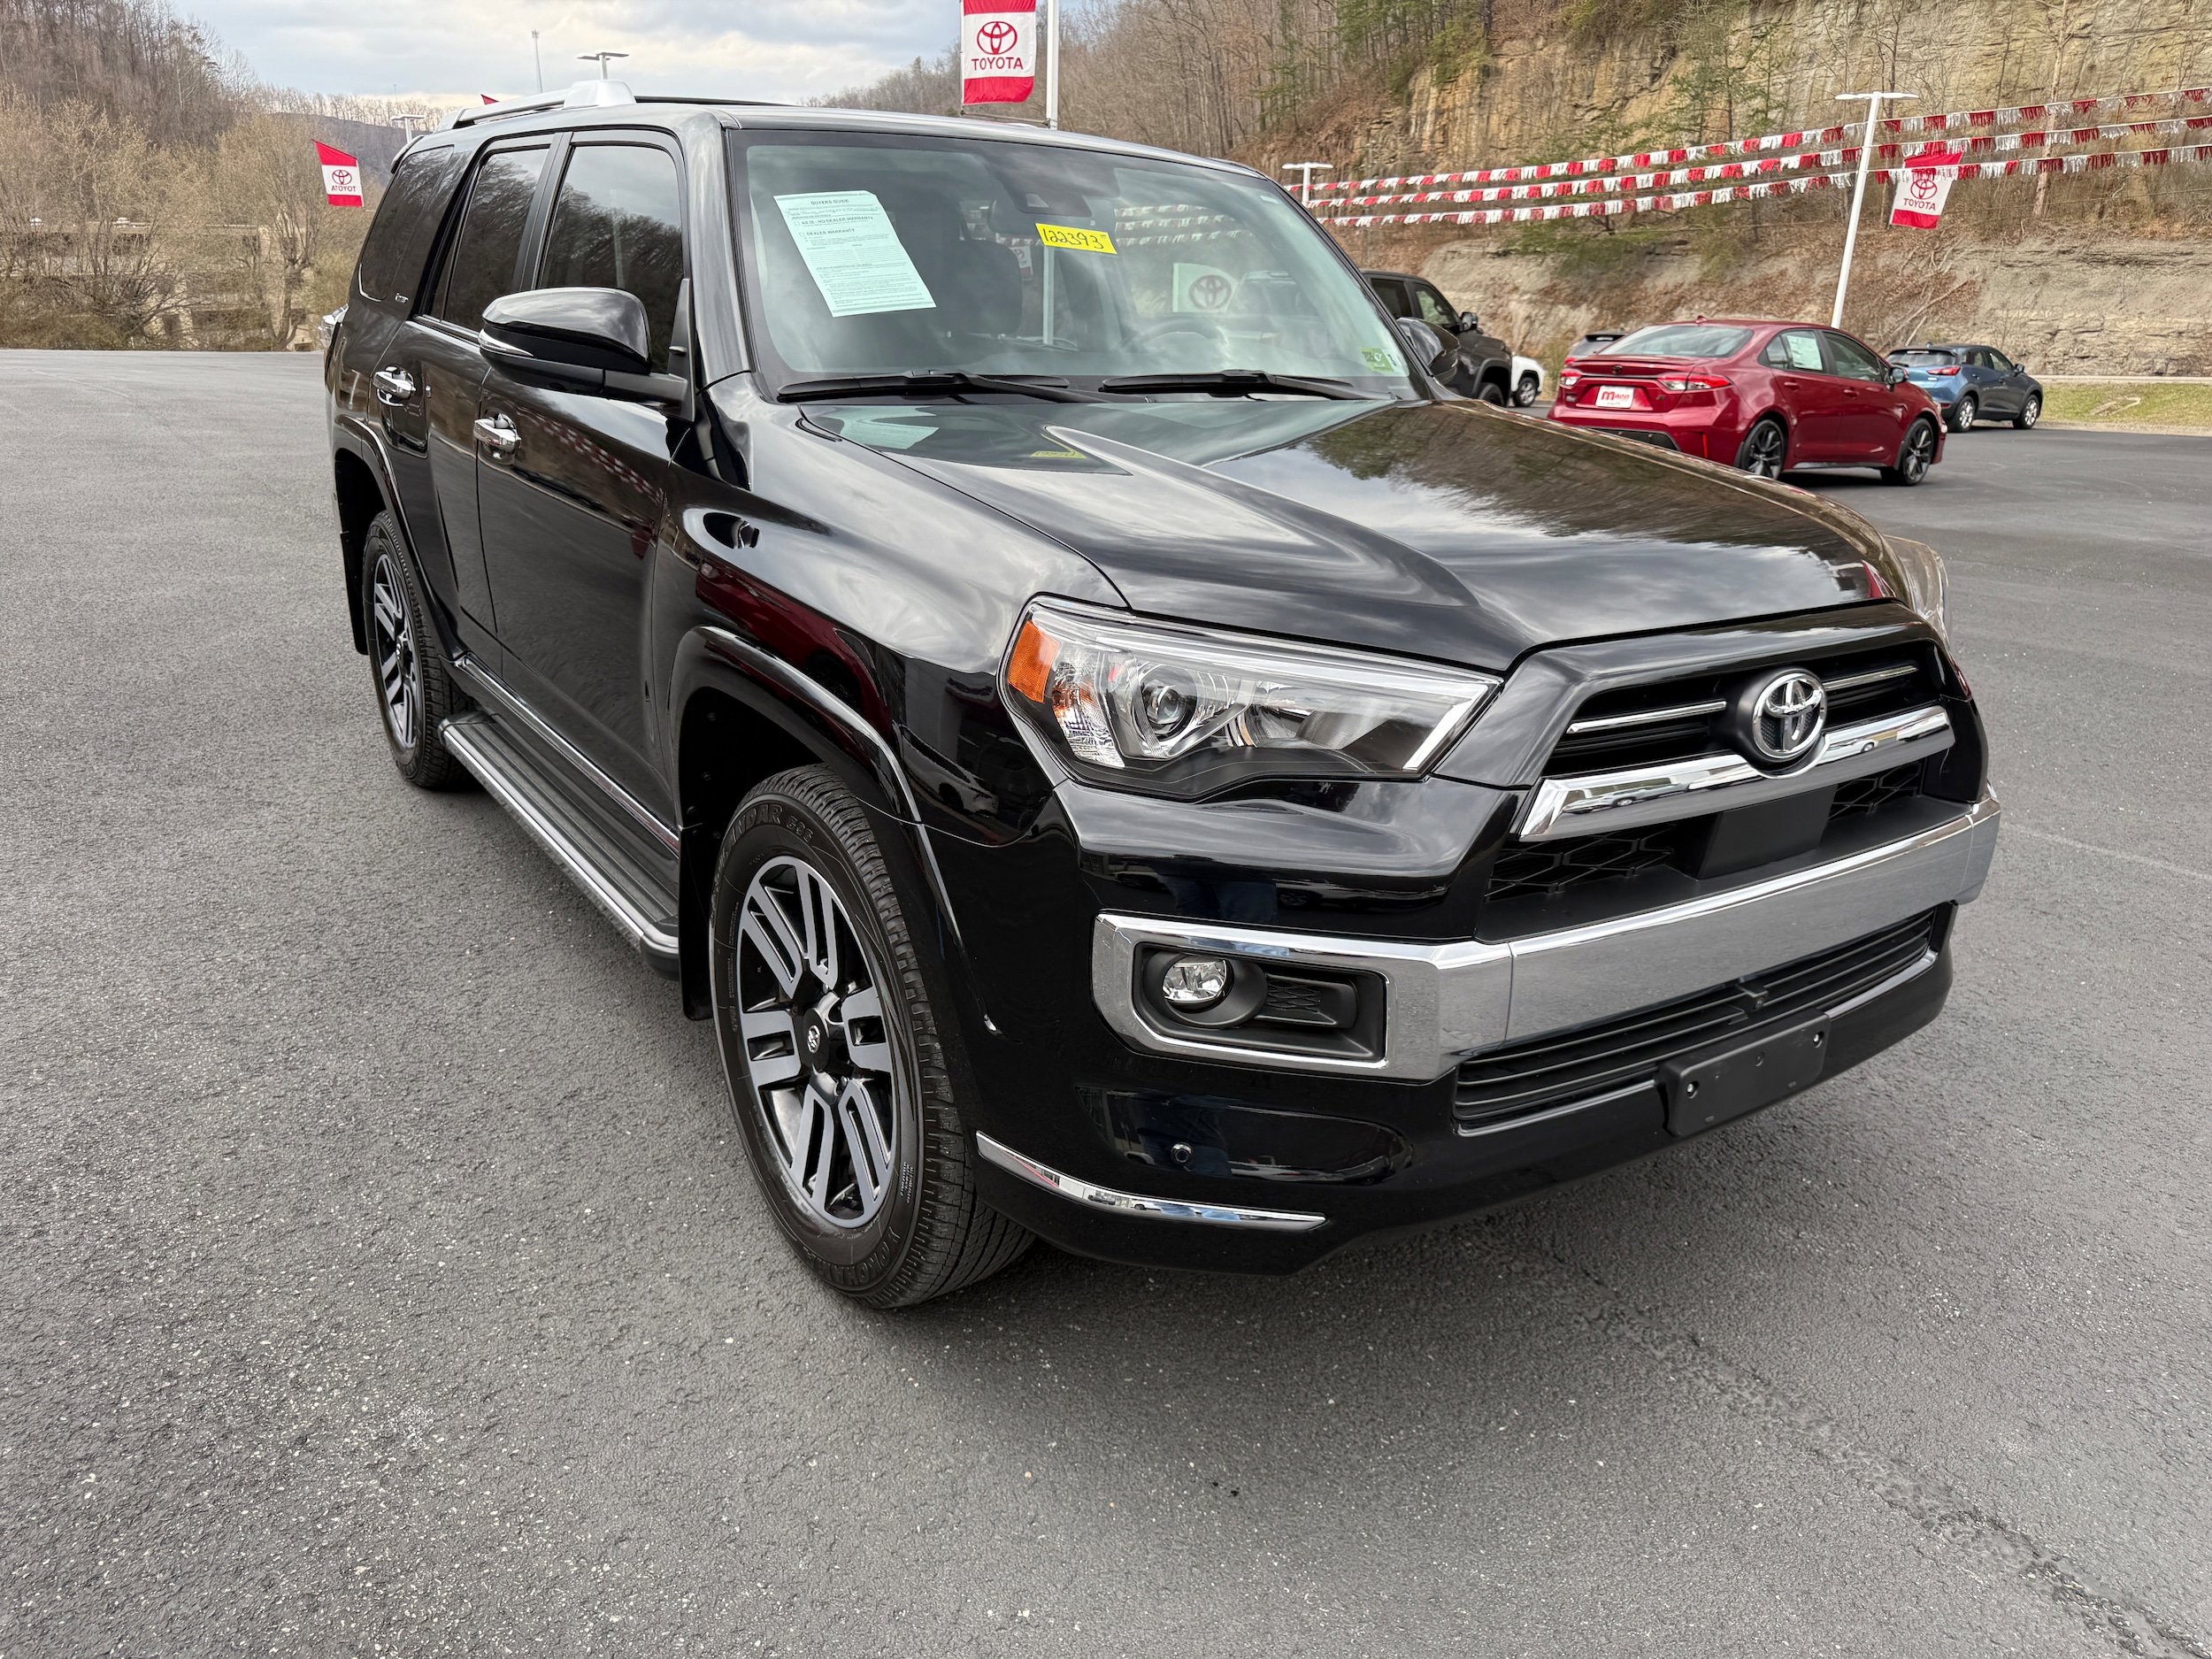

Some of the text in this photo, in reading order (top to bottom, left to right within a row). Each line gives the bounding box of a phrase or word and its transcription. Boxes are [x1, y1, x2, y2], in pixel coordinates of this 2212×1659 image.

[972, 57, 1024, 71] TOYOTA
[1903, 197, 1936, 211] TOYOTA
[1042, 227, 1104, 250] 122393
